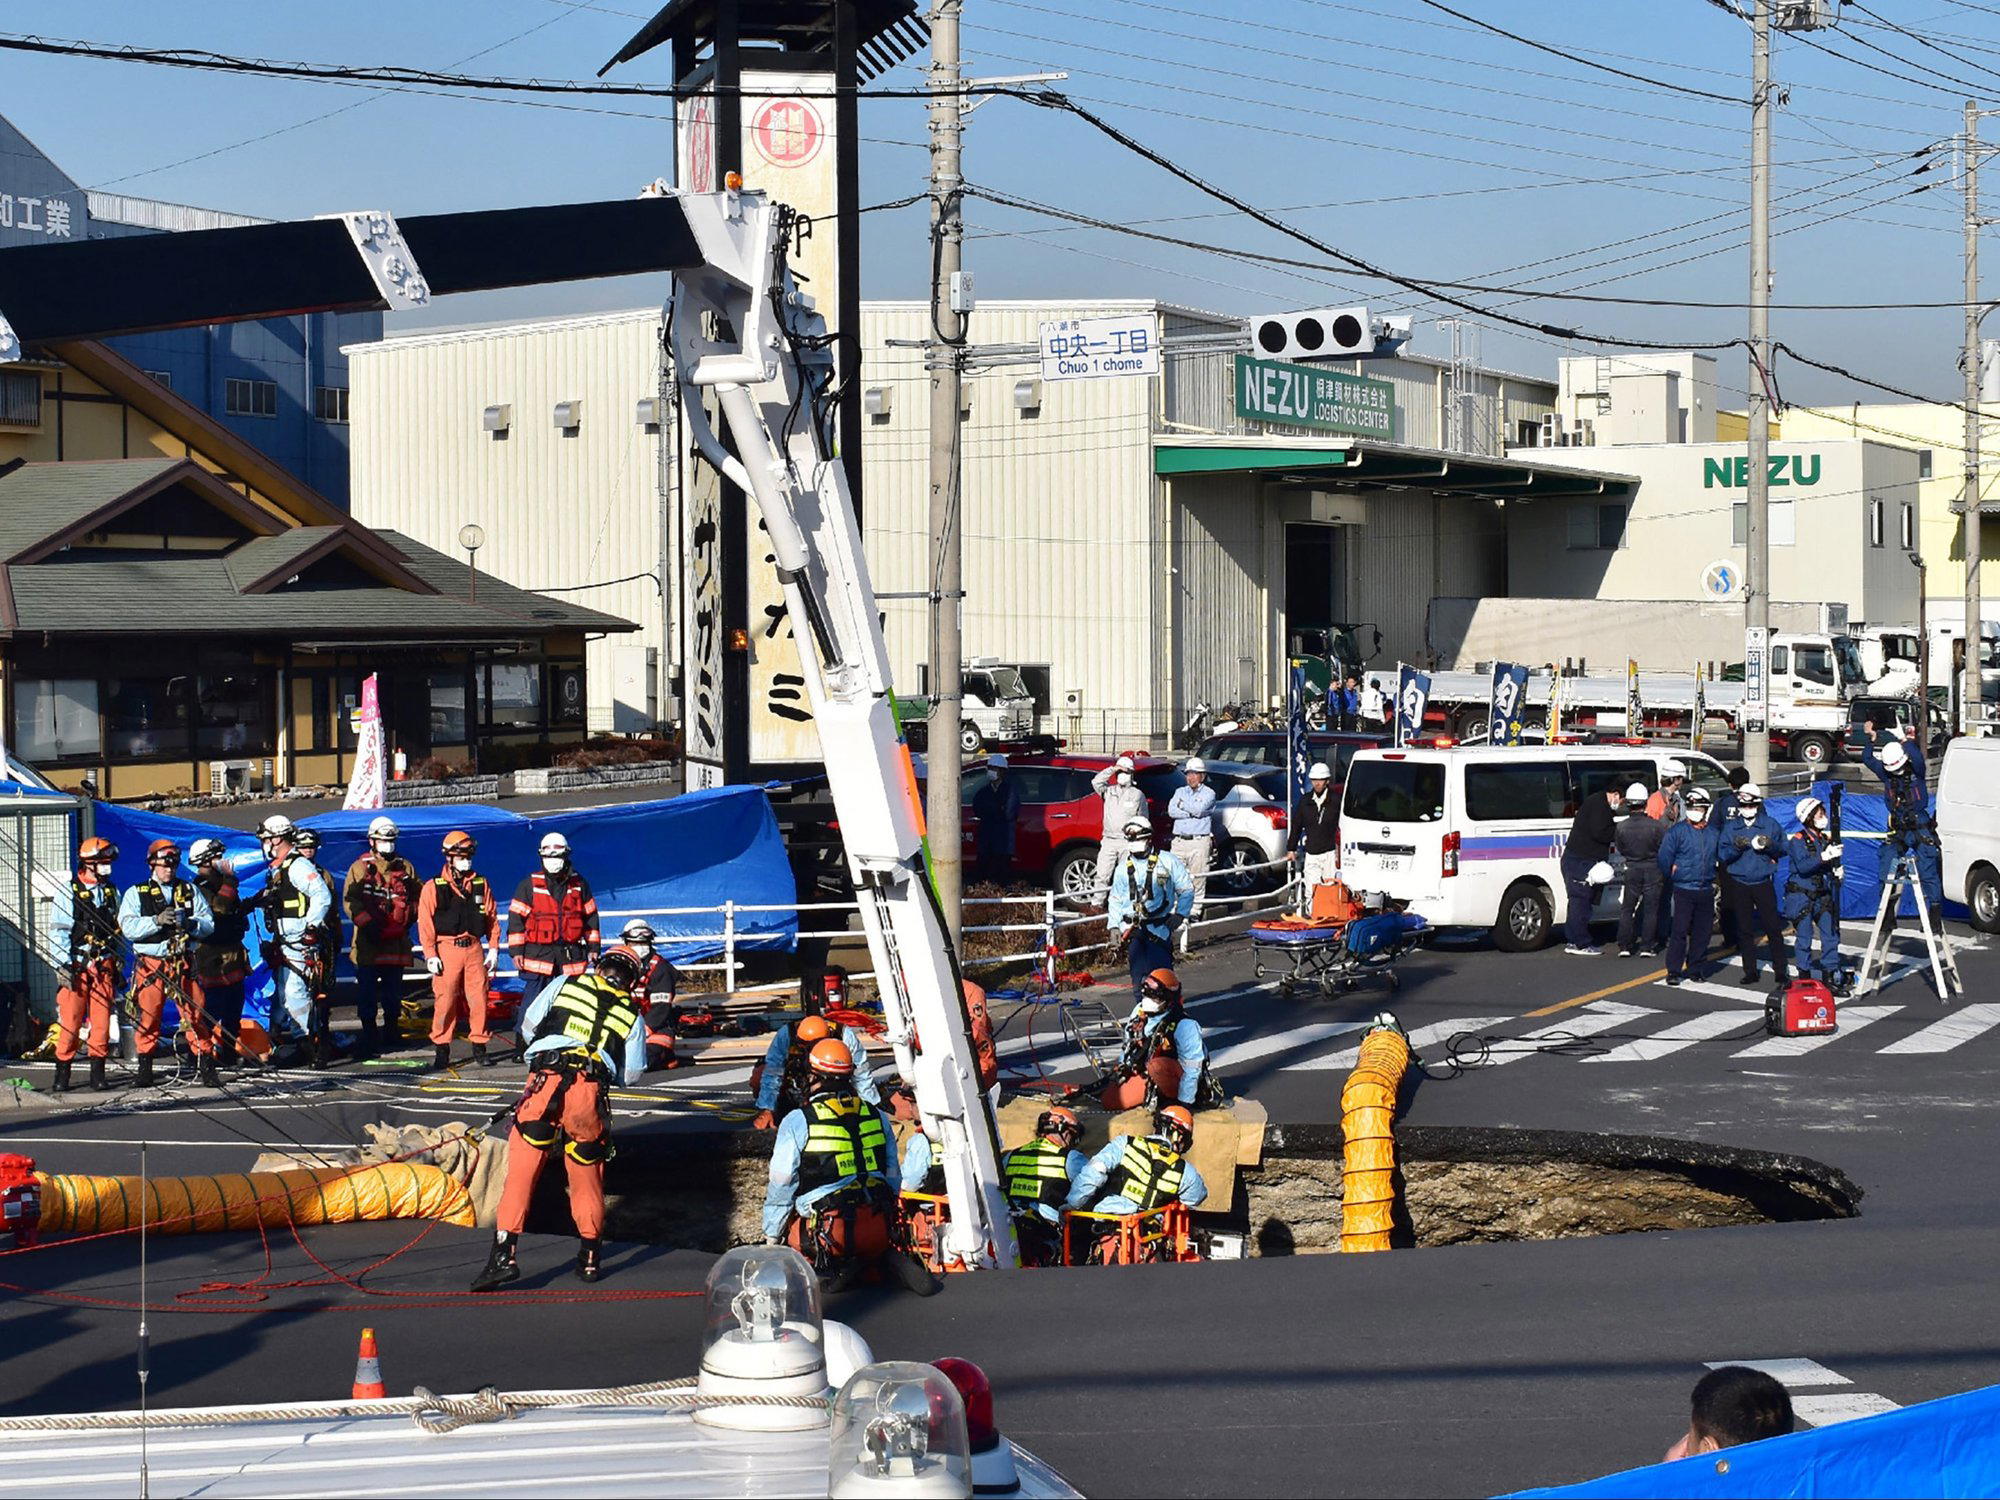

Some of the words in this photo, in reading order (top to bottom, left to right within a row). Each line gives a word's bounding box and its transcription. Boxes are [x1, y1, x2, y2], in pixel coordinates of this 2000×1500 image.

[1049, 329, 1148, 360] 中央一丁目
[1058, 360, 1089, 375] Chuo
[1093, 359, 1098, 372] 1
[1103, 357, 1143, 371] chome
[1245, 364, 1309, 419] NEZU
[1314, 402, 1357, 426] LOGISTICS
[1358, 409, 1390, 431] CENTER
[1703, 454, 1821, 489] NEZU
